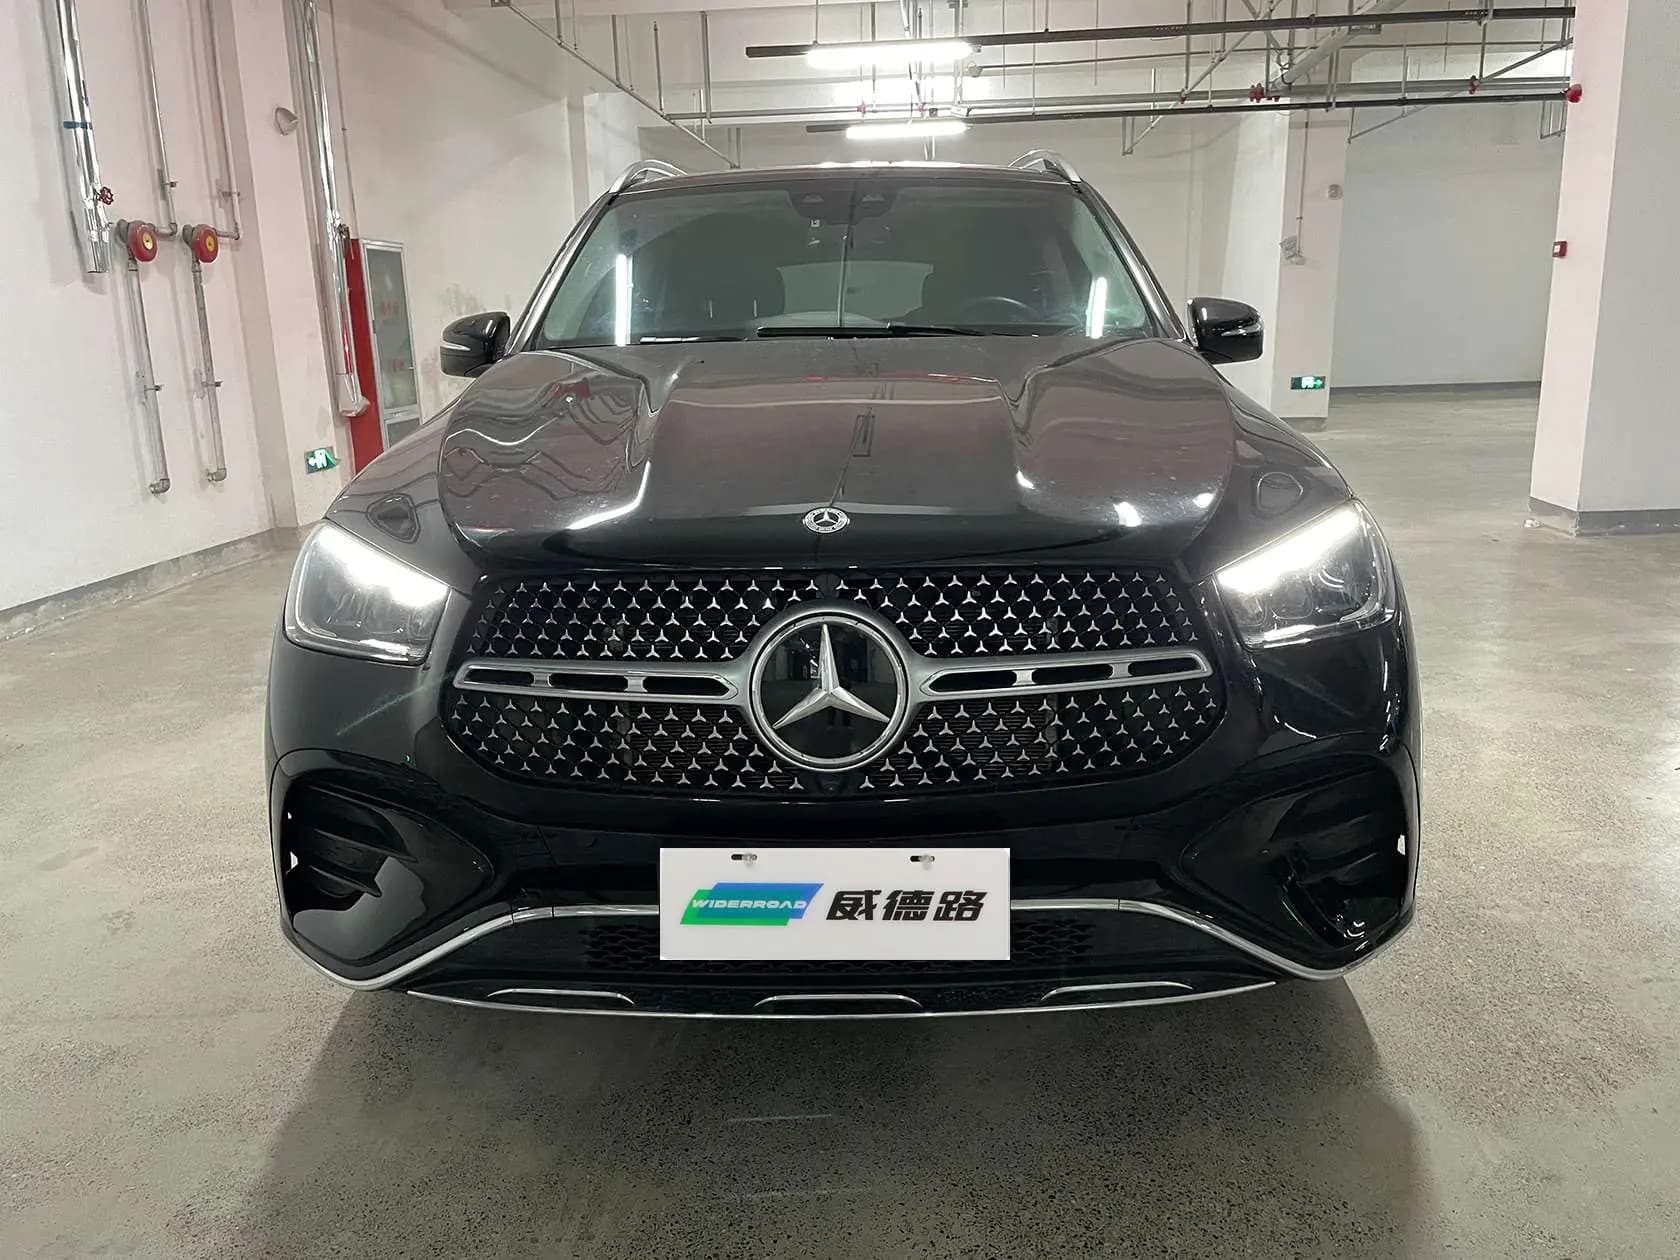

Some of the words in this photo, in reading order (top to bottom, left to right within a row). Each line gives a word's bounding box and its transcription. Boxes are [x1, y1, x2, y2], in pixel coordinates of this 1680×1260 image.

[692, 899, 808, 909] WIDERROAD
[826, 889, 988, 922] 威德路
